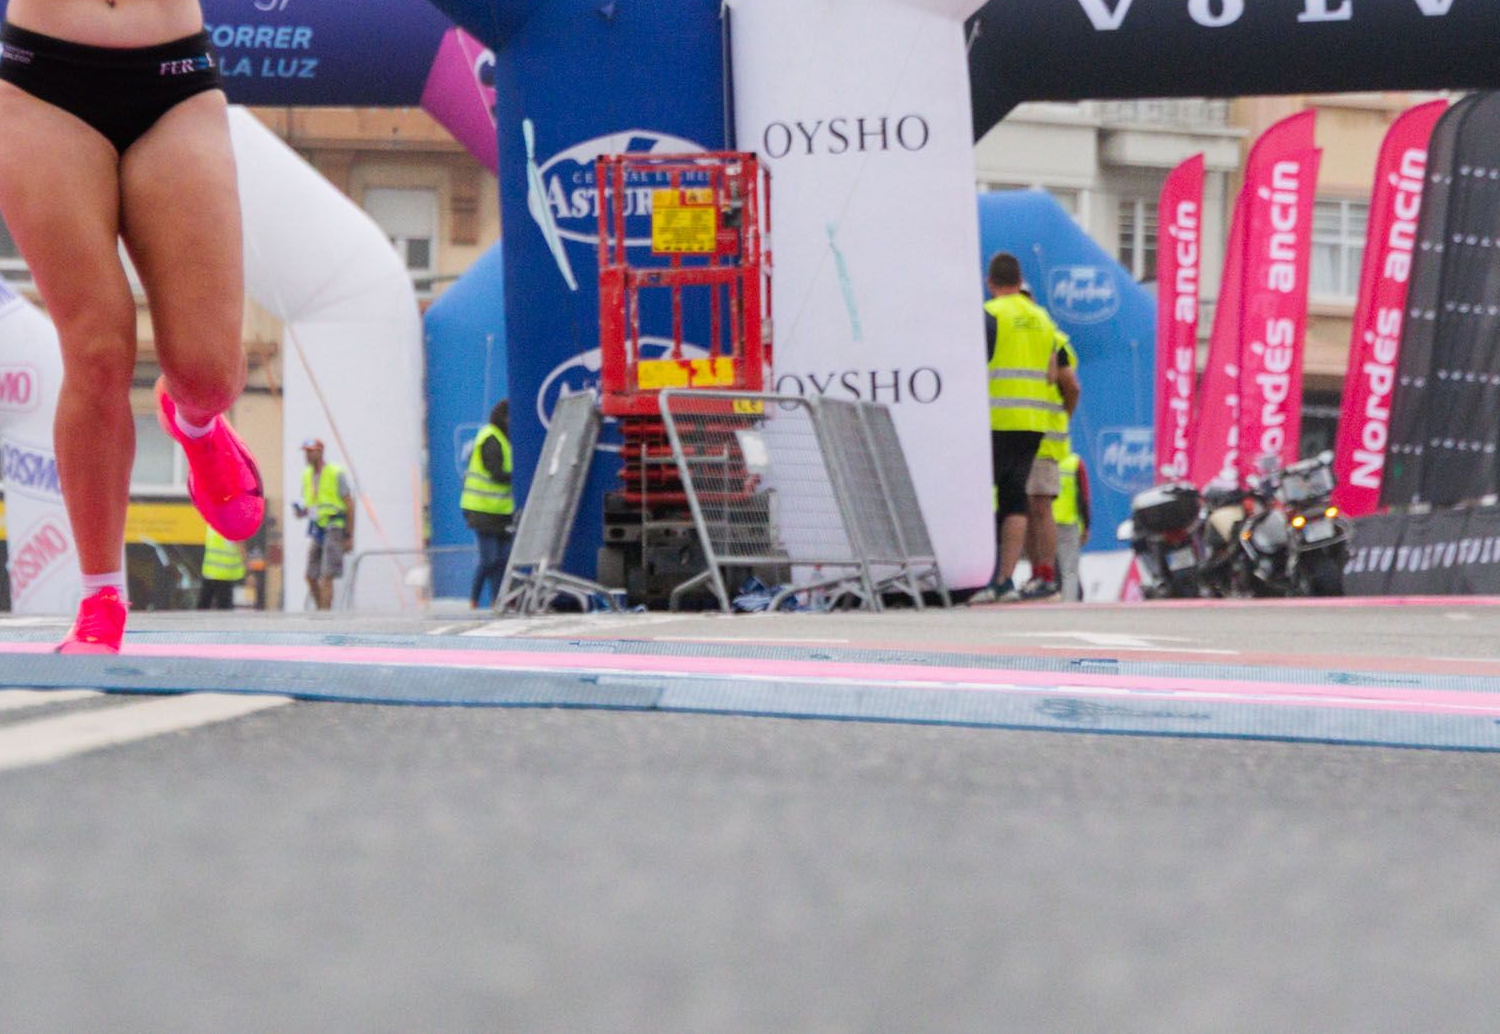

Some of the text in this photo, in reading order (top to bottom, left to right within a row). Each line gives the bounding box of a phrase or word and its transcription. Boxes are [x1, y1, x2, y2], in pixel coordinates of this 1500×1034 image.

[202, 26, 313, 50] ORRER
[260, 59, 318, 78] LUZ
[763, 114, 931, 159] OYSHO
[1257, 161, 1301, 294] ancín
[1385, 148, 1429, 282] ancín
[1250, 319, 1295, 456] ordés
[1350, 307, 1402, 489] Nordés
